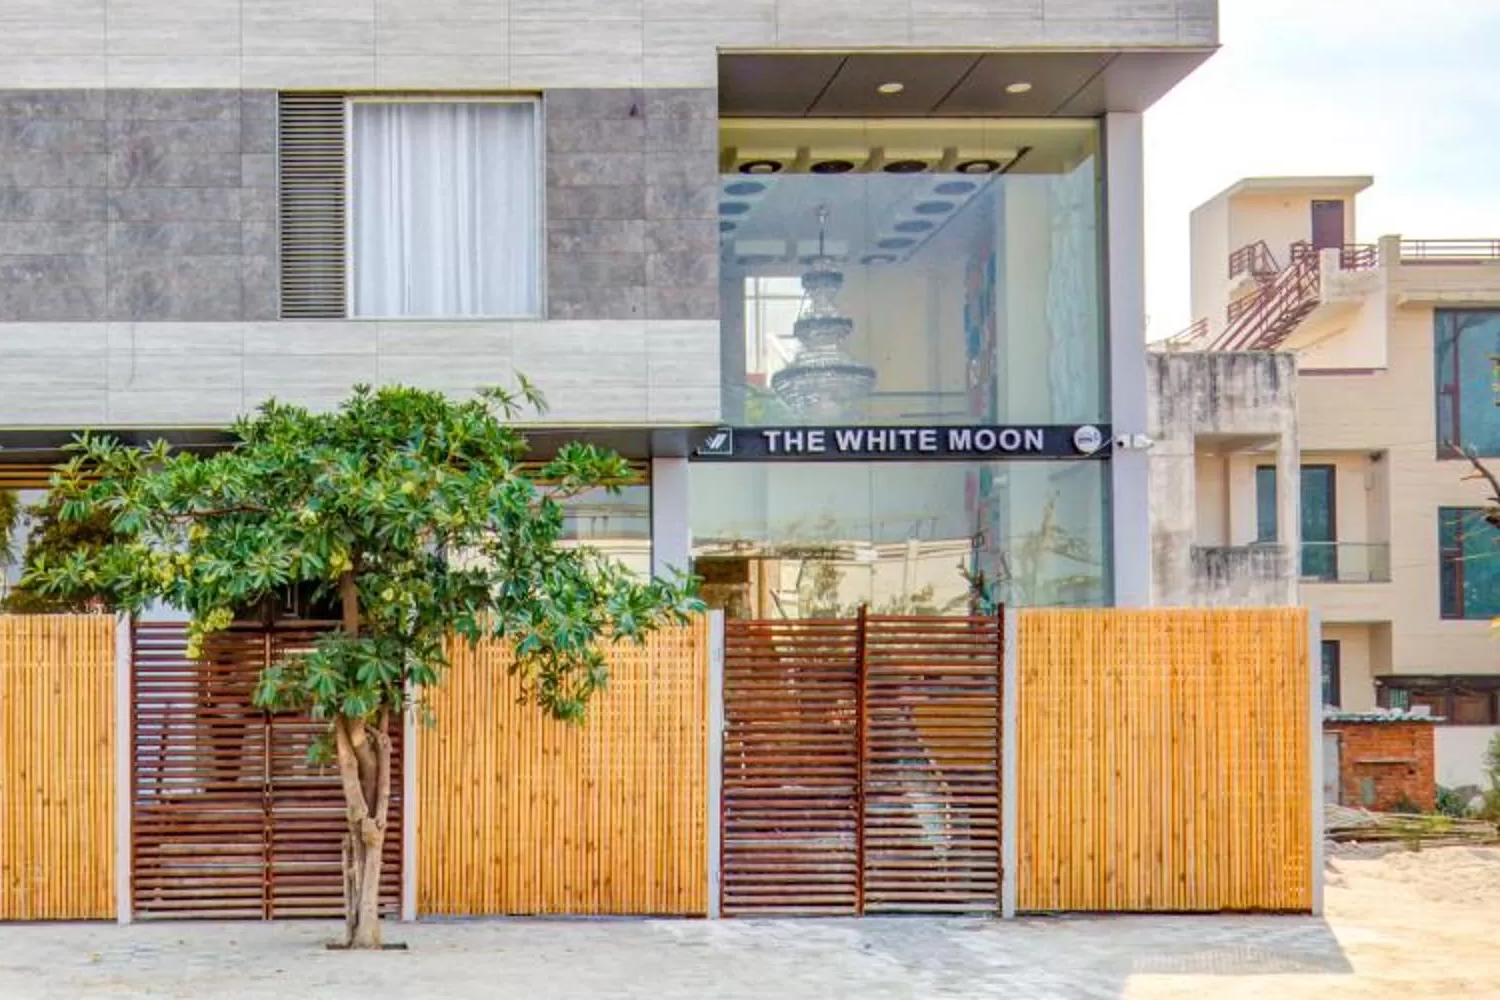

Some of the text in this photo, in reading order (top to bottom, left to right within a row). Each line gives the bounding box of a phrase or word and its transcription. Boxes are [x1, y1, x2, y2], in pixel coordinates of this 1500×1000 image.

[762, 427, 1046, 453] THE WHITE MOON
